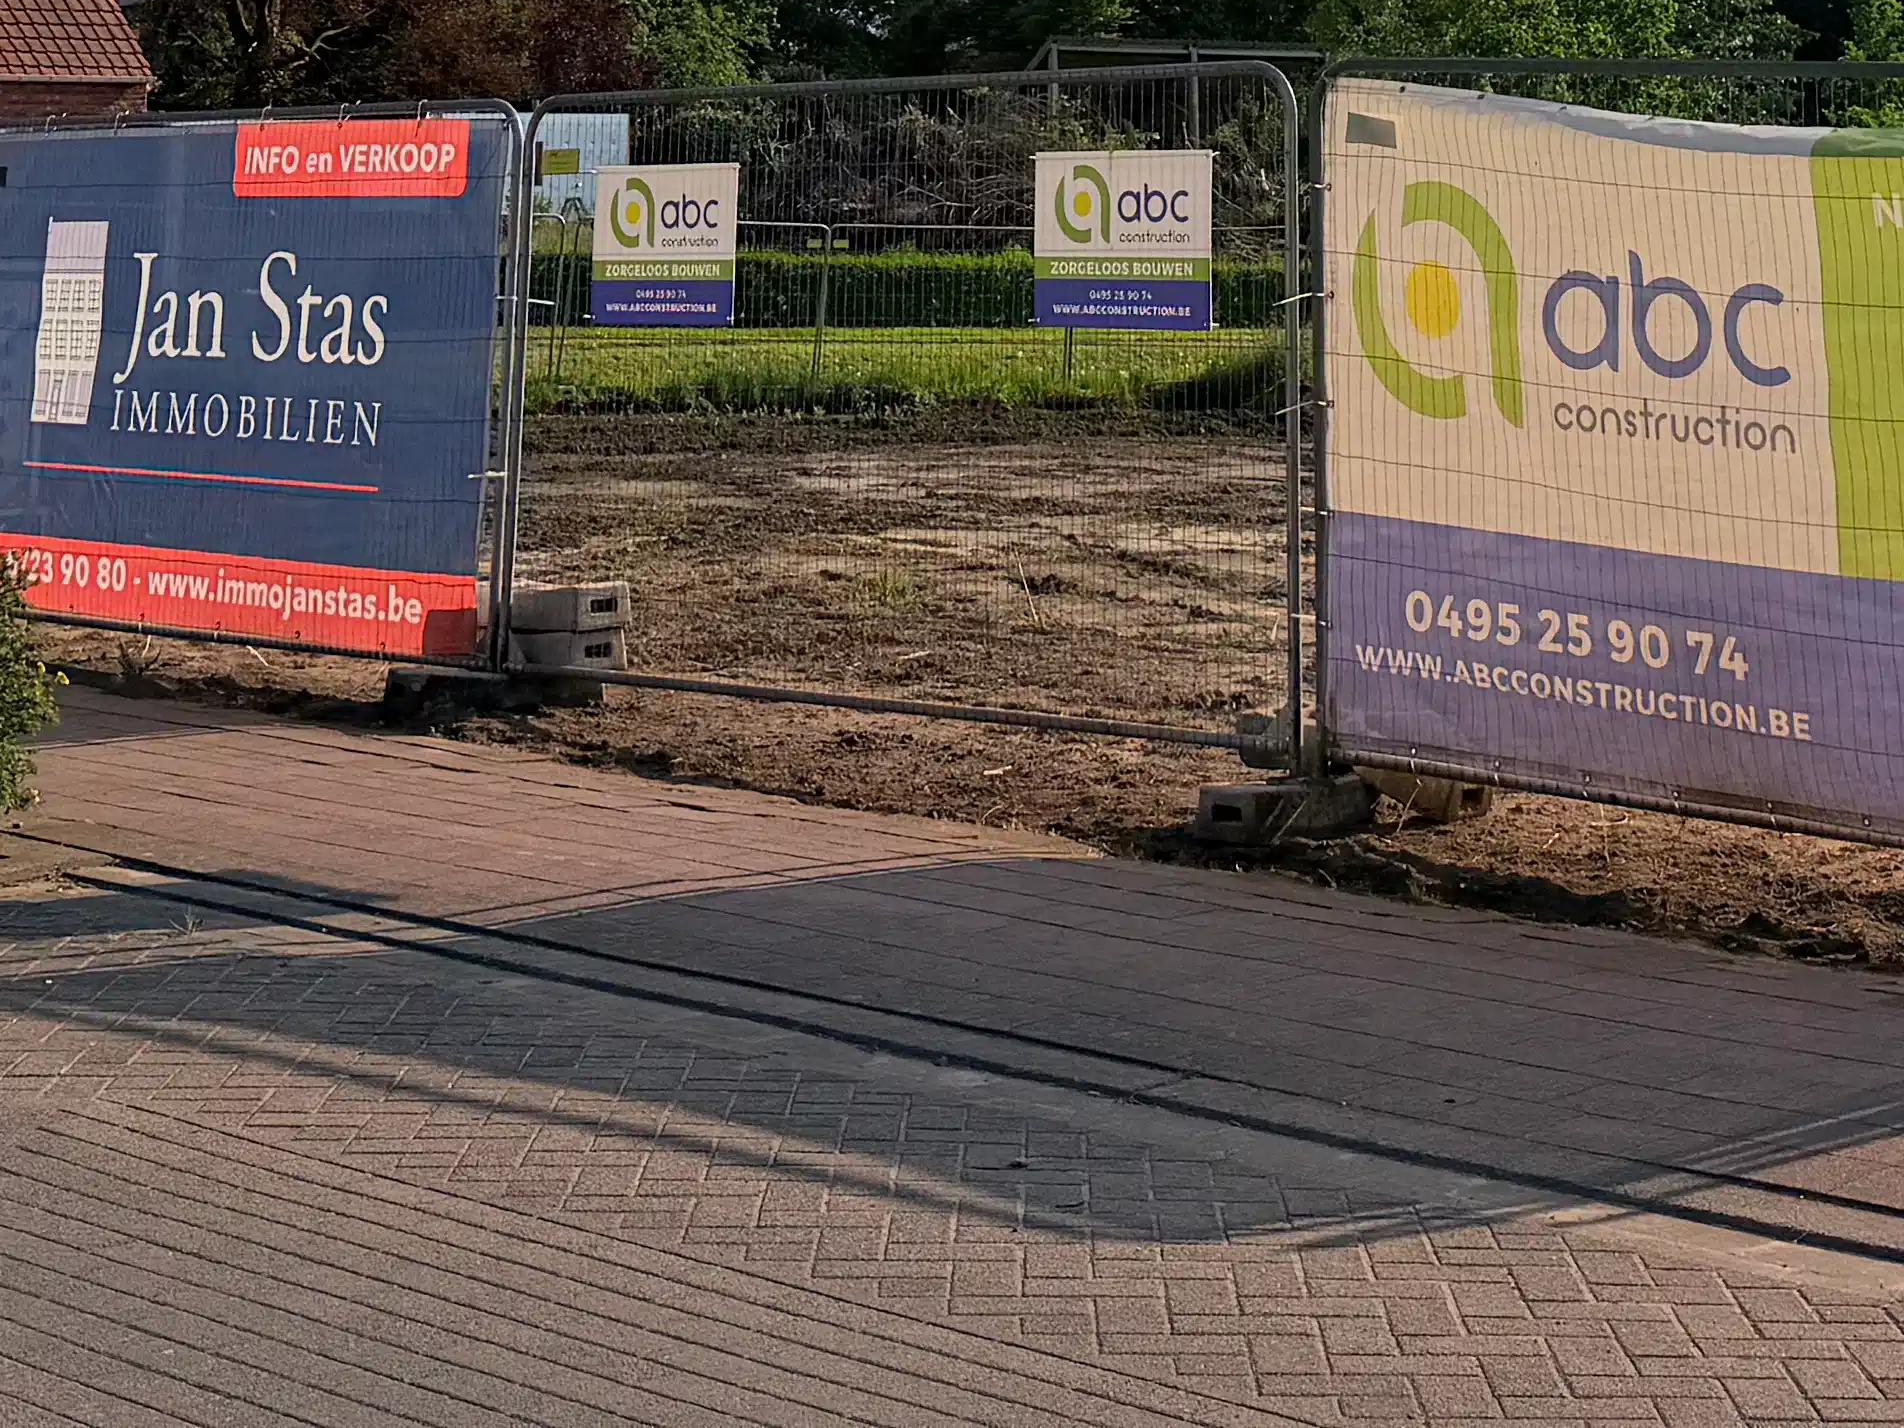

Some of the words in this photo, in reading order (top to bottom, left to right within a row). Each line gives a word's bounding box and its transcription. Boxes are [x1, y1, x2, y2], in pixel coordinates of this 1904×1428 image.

[244, 146, 299, 176] INFO
[306, 154, 333, 174] en
[339, 143, 456, 175] VERKOOP
[661, 193, 719, 229] abc
[1117, 182, 1189, 223] abc
[661, 234, 719, 248] construction
[1119, 229, 1190, 243] construction
[605, 264, 669, 277] ZORGELOOS
[672, 264, 720, 277] BOUWEN
[1050, 261, 1129, 275] ZORGELOOS
[1132, 262, 1193, 276] BOUWEN
[112, 252, 226, 385] Jan
[251, 250, 389, 367] Stas
[1052, 304, 1191, 317] WWW.ABCCONSTRUCTION.BE
[1542, 249, 1791, 387] abc
[110, 389, 383, 446] IMMOBILIEN
[1553, 398, 1796, 454] construction
[60, 553, 90, 588] 90
[97, 557, 126, 592] 80
[148, 567, 423, 625] www.immojanstas.be
[1404, 589, 1522, 646] 0495
[1538, 609, 1593, 657] 25
[1608, 619, 1670, 668] 90
[1685, 630, 1749, 681] 74
[1354, 643, 1811, 741] WWW.ABCCONSTRUCTION.BE
